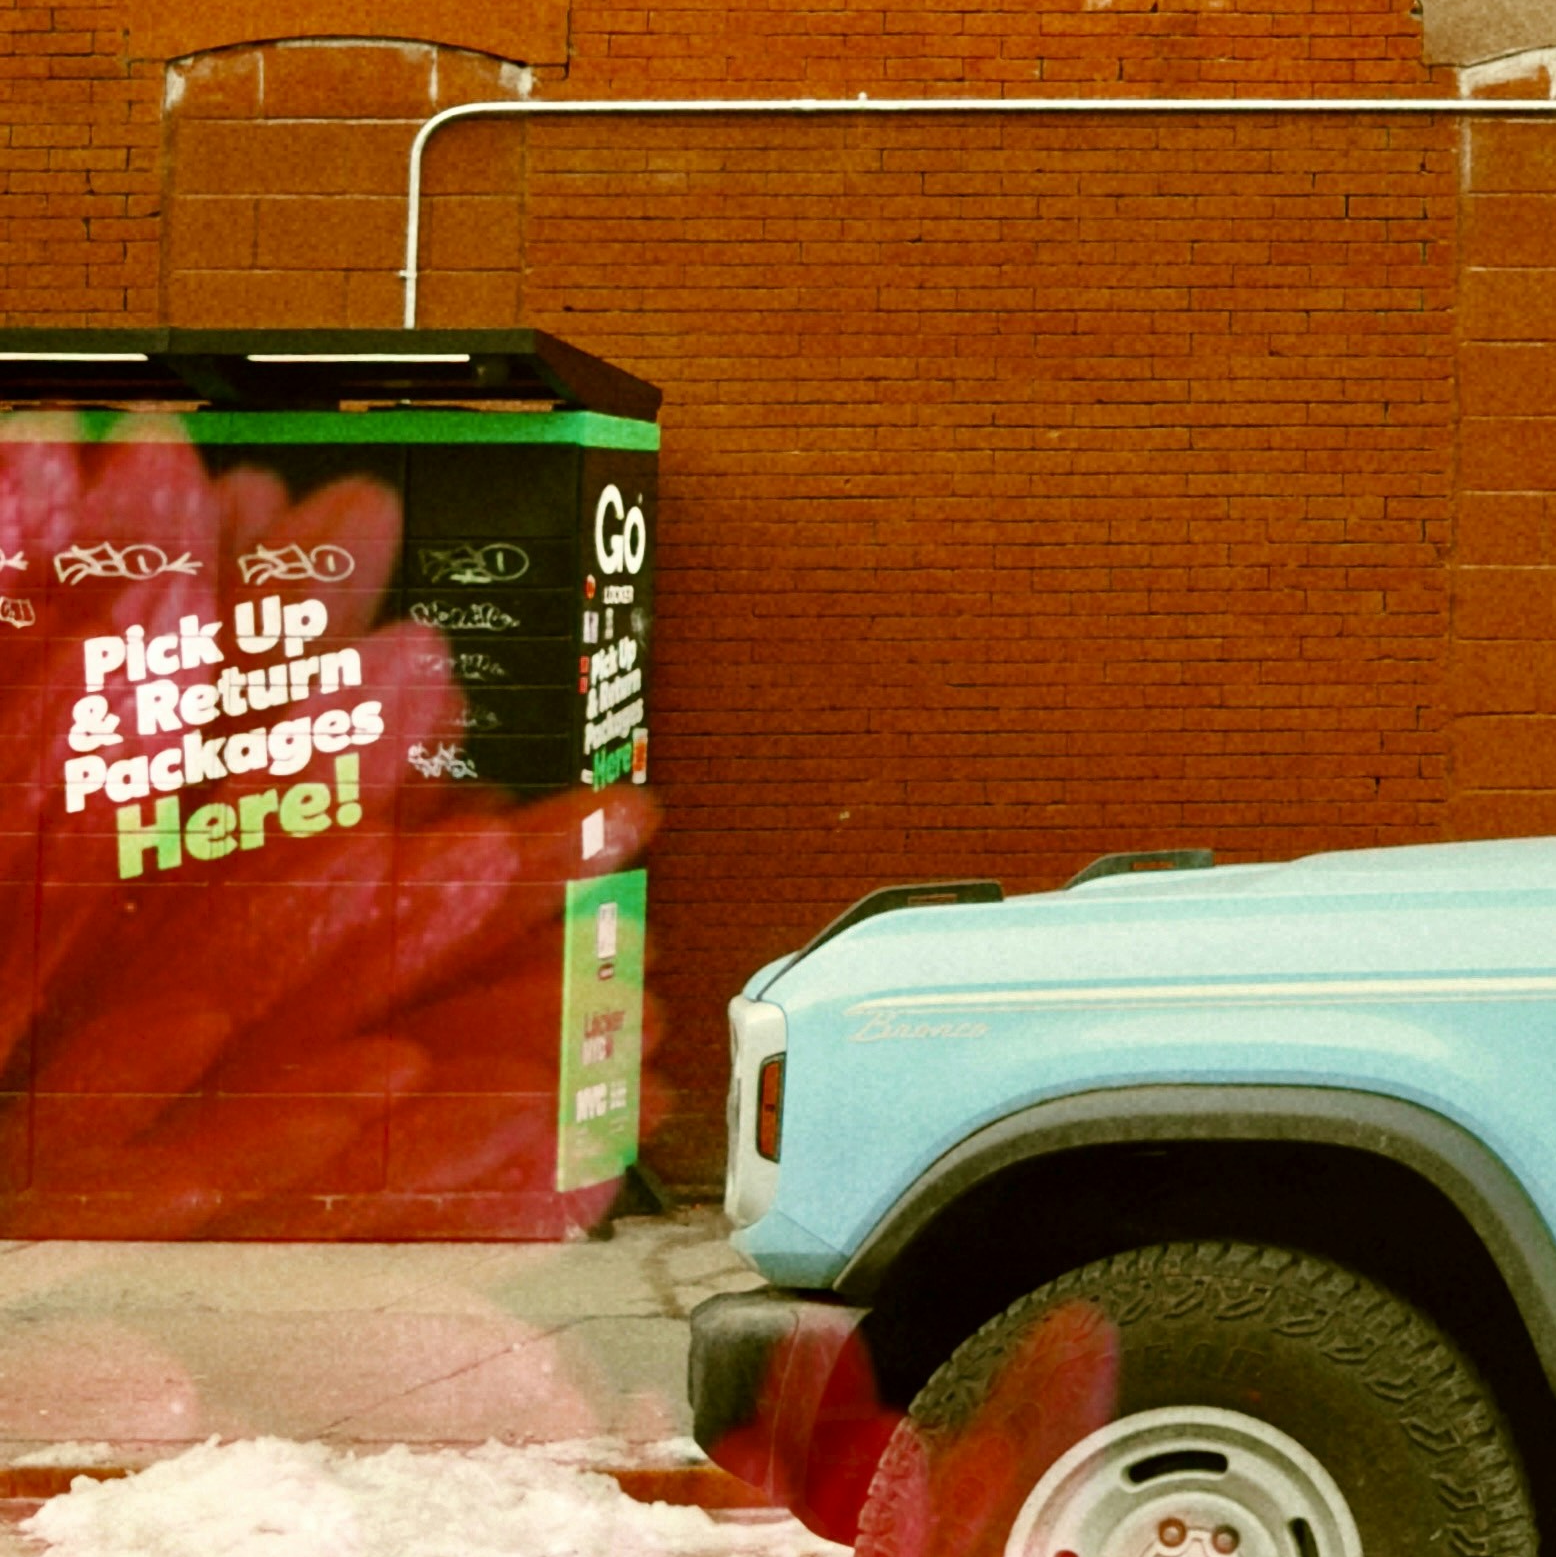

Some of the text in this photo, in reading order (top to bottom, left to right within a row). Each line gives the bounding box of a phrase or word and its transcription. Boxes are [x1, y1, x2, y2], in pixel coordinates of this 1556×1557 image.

[594, 484, 646, 575] Go
[84, 614, 225, 692] Pick
[234, 595, 328, 659] Up
[68, 647, 362, 753] & Return
[65, 700, 385, 814] Packages
[117, 752, 363, 879] Here!
[850, 1012, 991, 1044] Bronco
